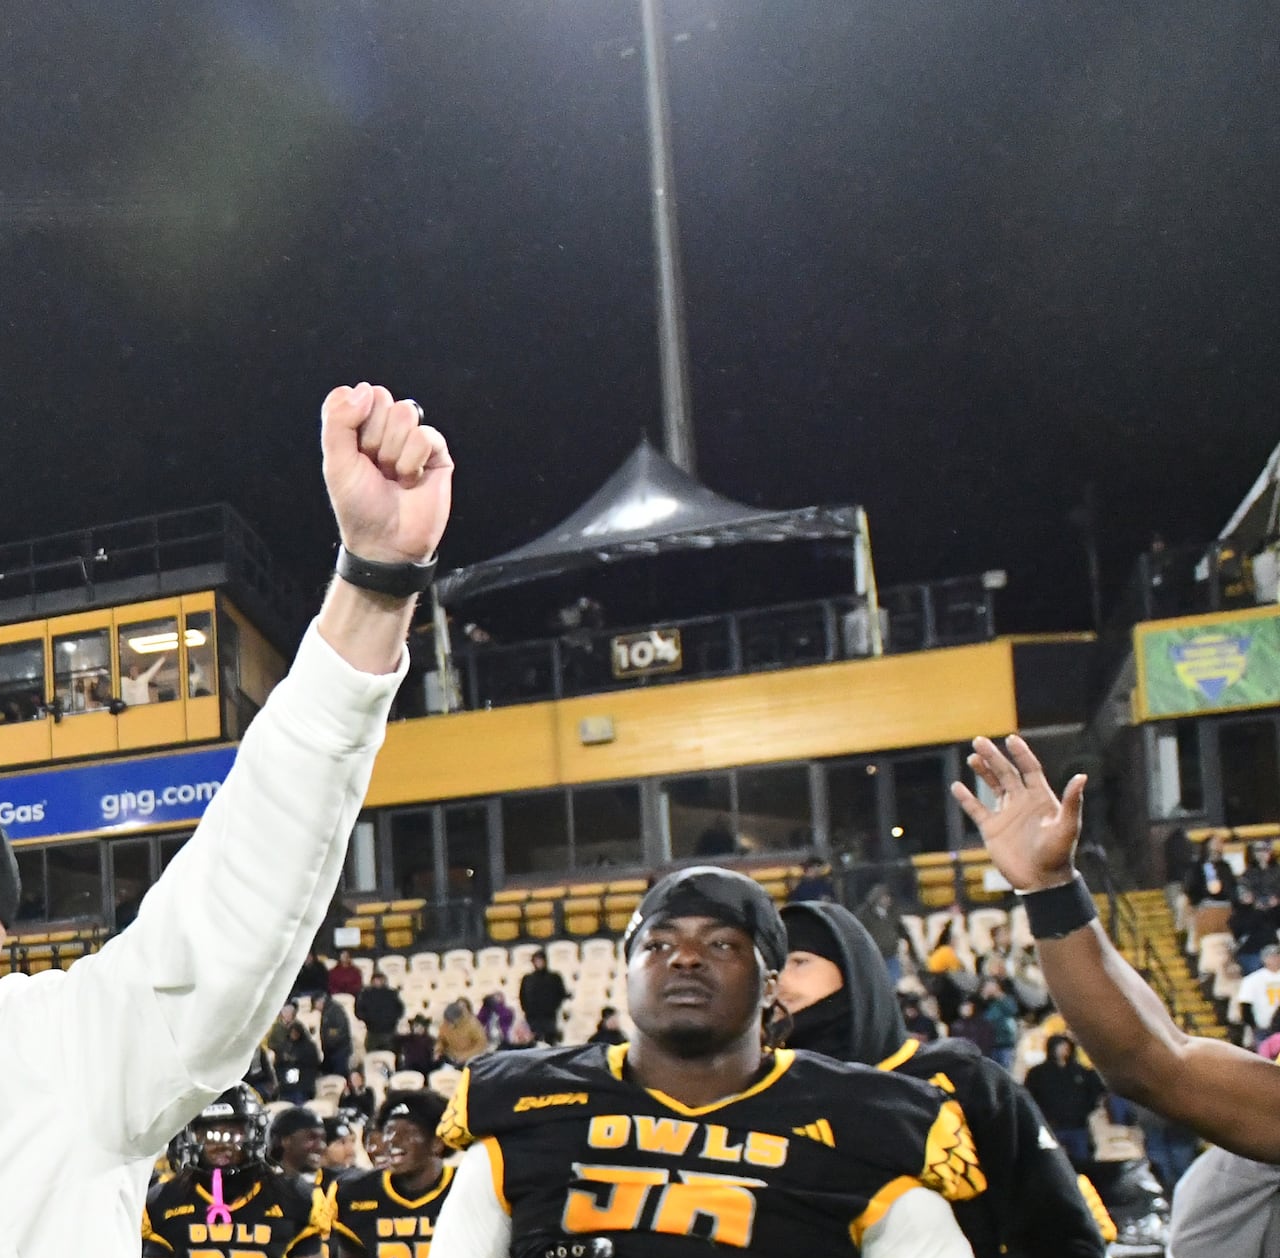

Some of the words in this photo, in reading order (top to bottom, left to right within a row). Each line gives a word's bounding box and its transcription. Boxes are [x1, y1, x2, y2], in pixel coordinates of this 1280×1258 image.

[101, 781, 222, 819] gng.com
[587, 1114, 789, 1168] OWLS
[189, 1223, 272, 1244] OWLS
[376, 1216, 435, 1238] OWL
